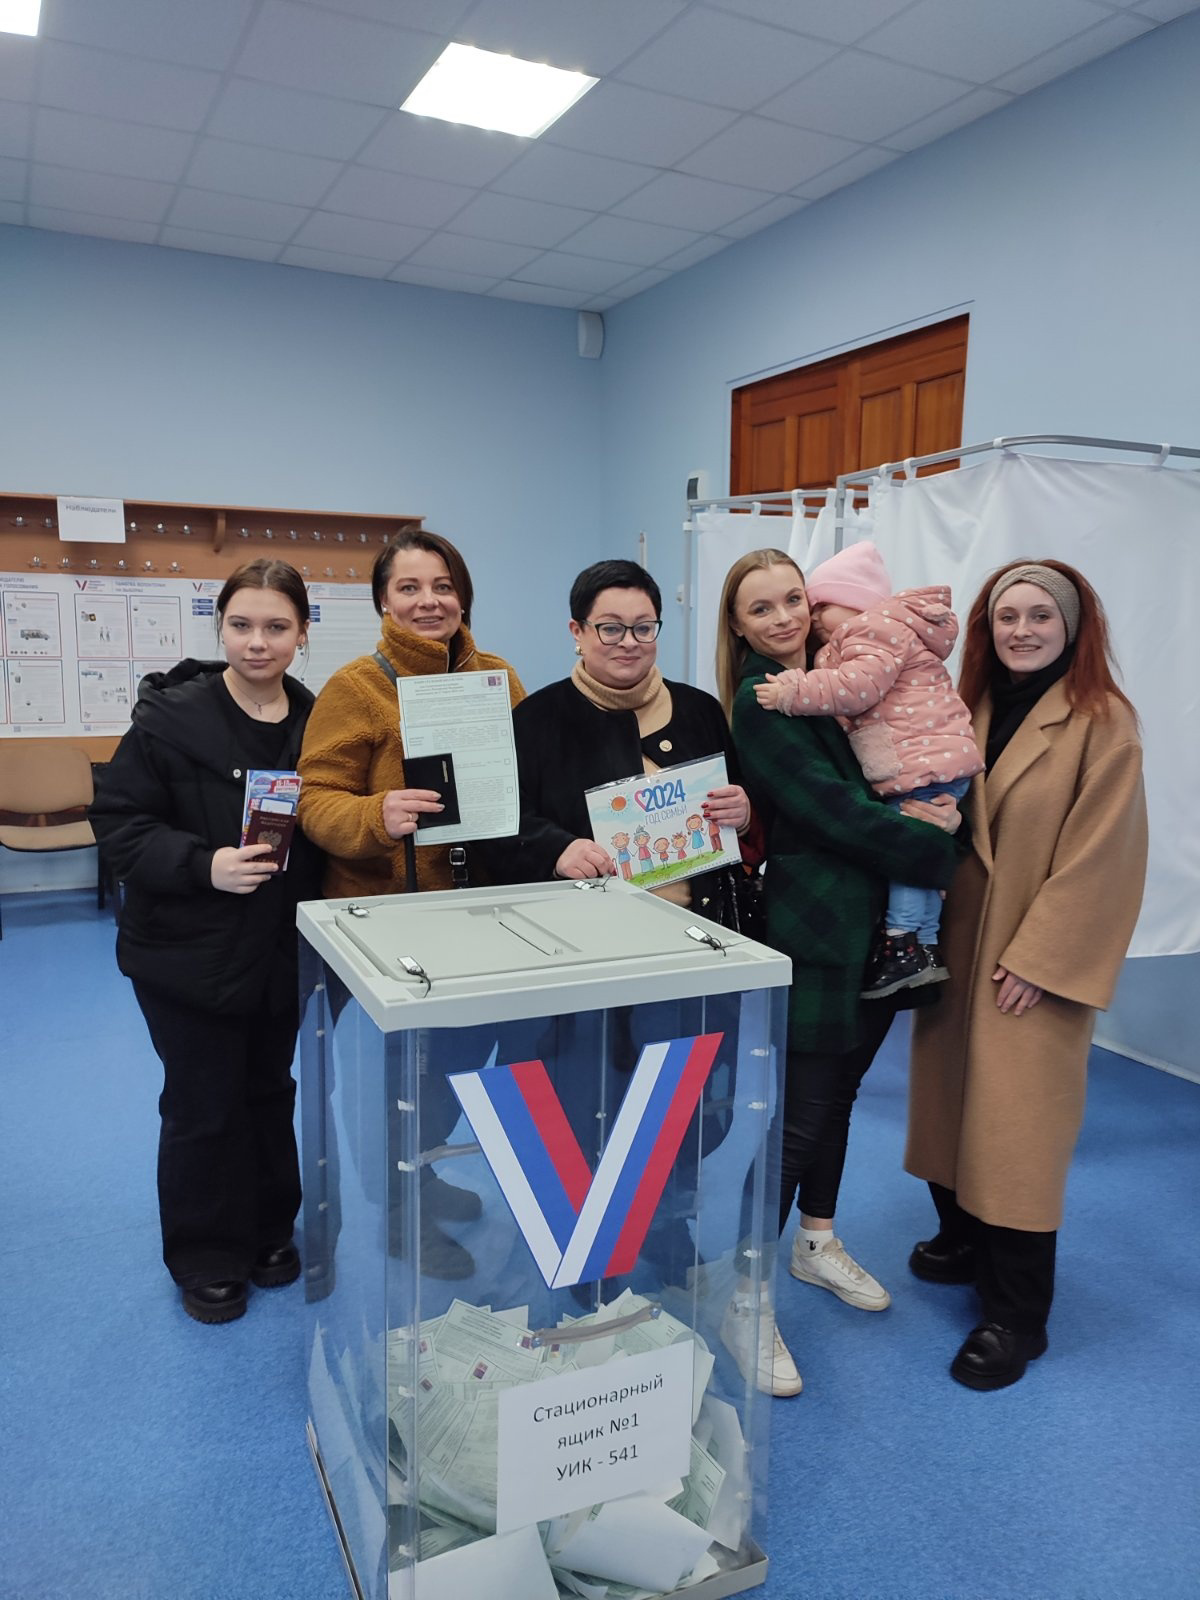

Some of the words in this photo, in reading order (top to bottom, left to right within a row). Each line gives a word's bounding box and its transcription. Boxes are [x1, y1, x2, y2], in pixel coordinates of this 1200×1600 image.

[642, 779, 686, 812] 2024
[533, 1373, 663, 1423] Стационарный
[557, 1426, 604, 1449] ящик
[610, 1413, 639, 1433] №1
[556, 1457, 592, 1481] УИК
[608, 1444, 638, 1465] 541
